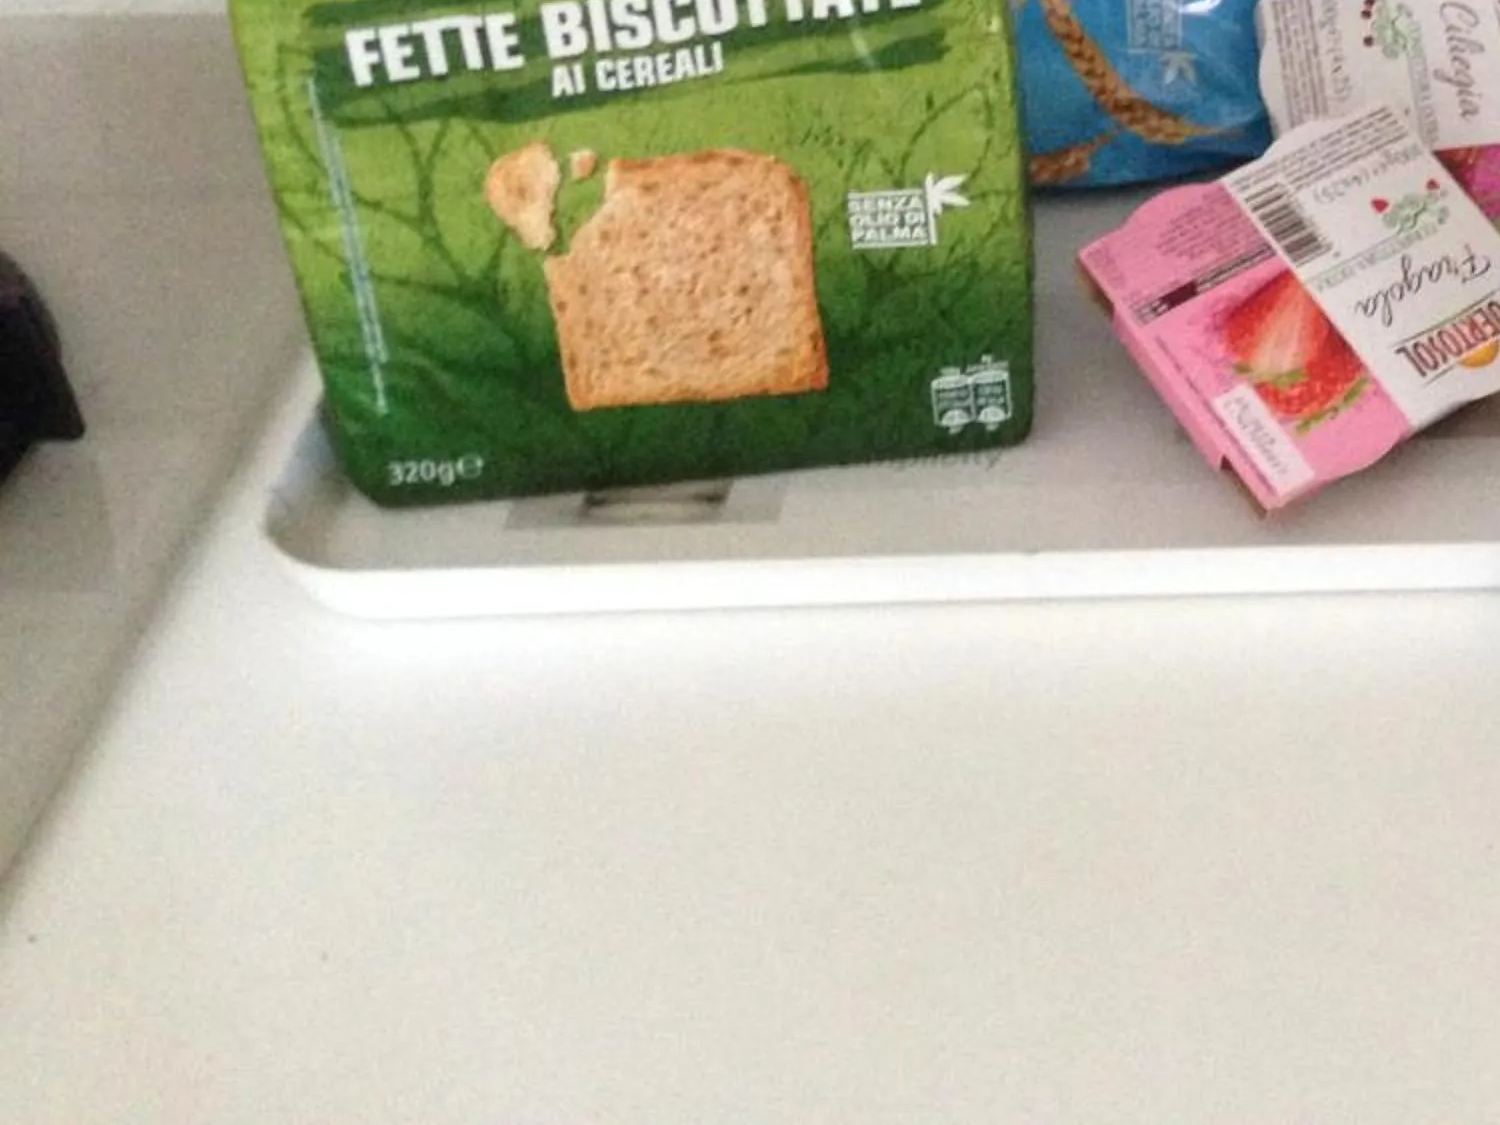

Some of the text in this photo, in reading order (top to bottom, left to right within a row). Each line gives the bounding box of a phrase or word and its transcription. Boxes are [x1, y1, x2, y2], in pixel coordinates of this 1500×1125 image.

[344, 11, 525, 88] FETTE
[551, 42, 724, 98] AI CEREALI
[1435, 0, 1484, 120] Ciliegia
[848, 195, 924, 212] SENZA
[850, 211, 926, 227] OLIO DI
[852, 226, 928, 243] PALMA
[1355, 245, 1492, 329] Fragola
